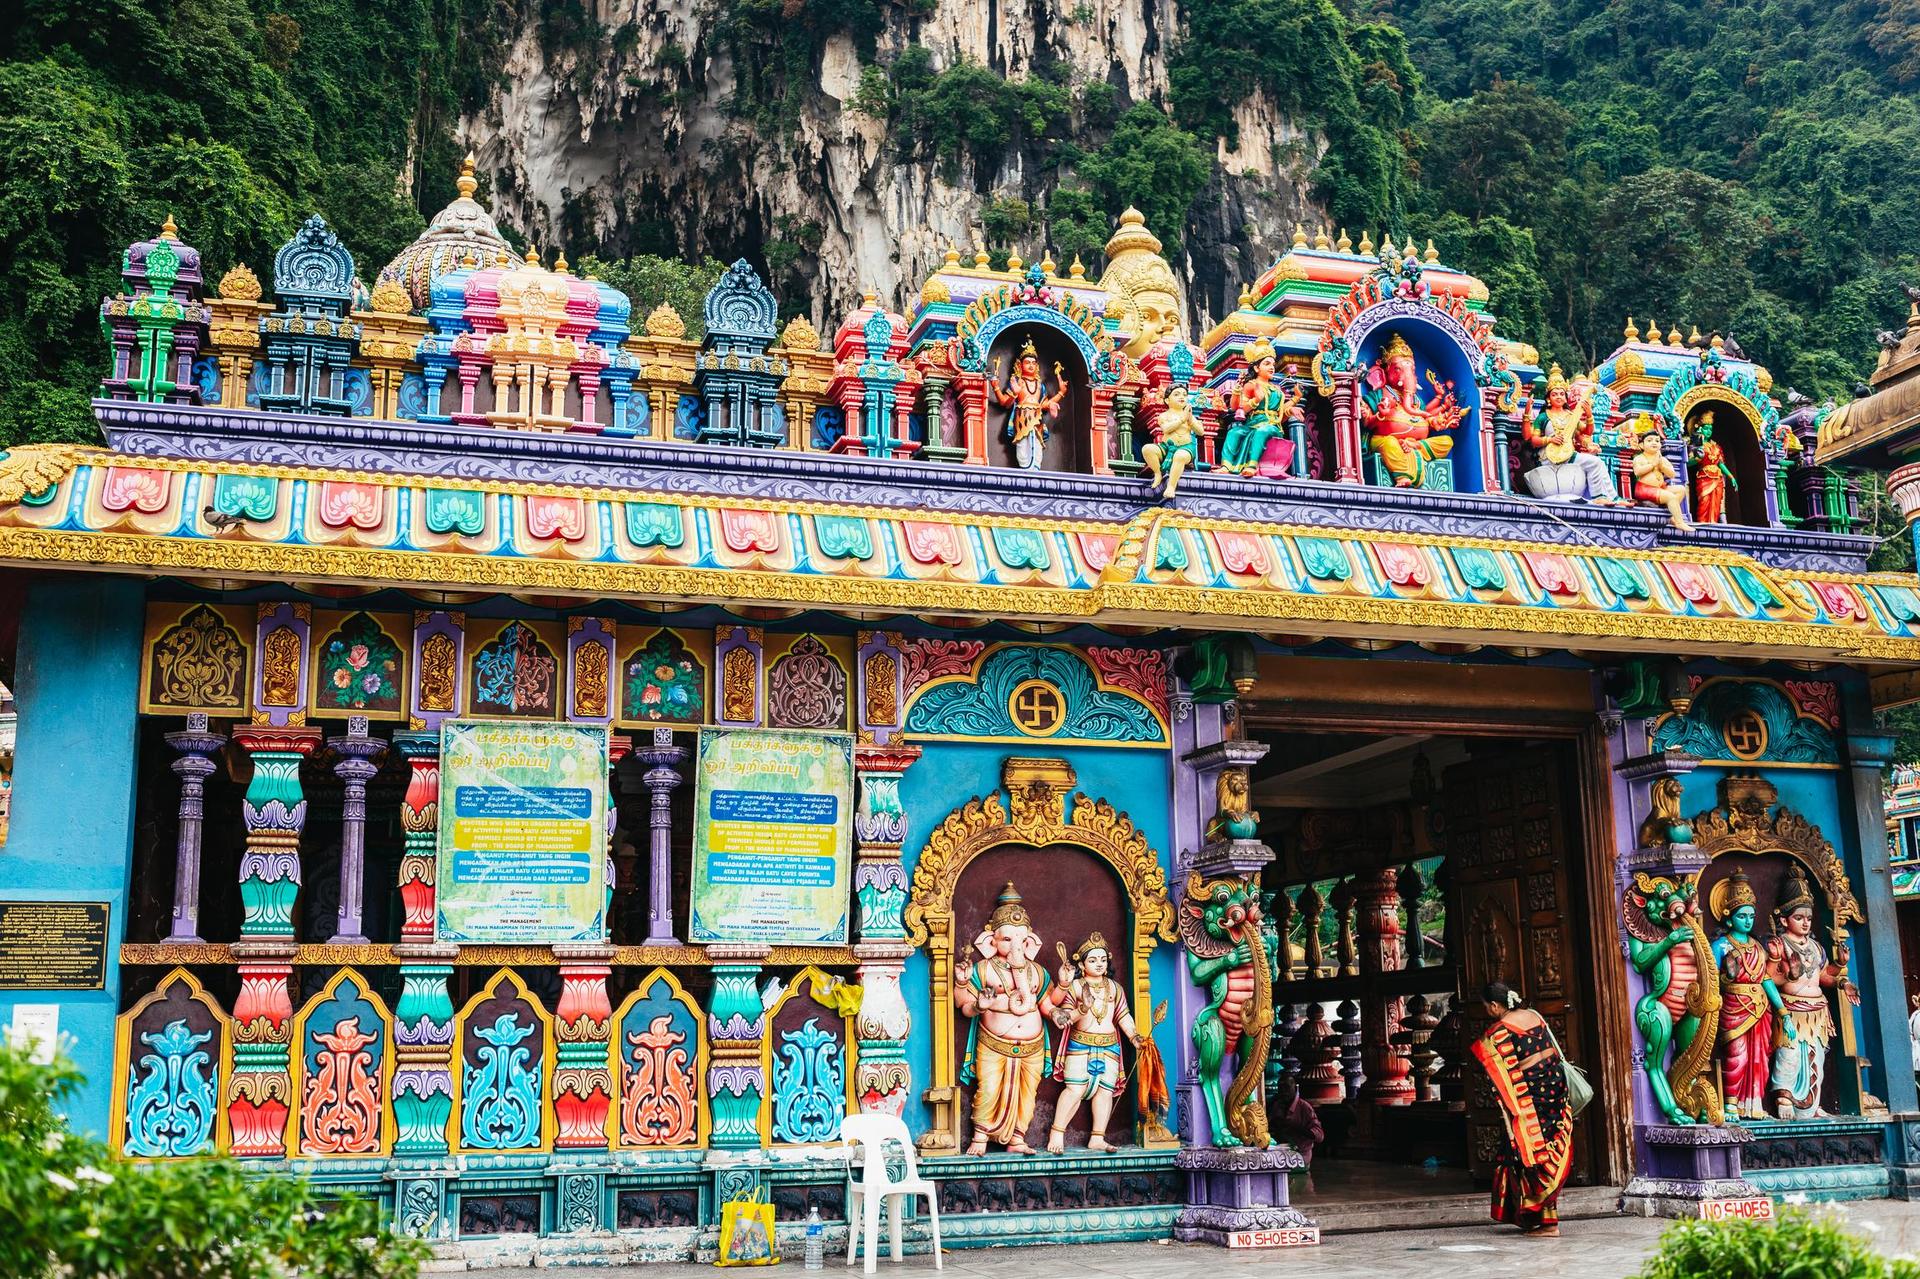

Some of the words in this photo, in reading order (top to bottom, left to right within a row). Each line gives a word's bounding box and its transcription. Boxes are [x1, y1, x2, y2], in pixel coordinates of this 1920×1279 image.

[1704, 1203, 1722, 1220] NO
[1724, 1201, 1770, 1218] SHOES
[1238, 1234, 1251, 1246] NO
[1255, 1232, 1298, 1245] SHOES
